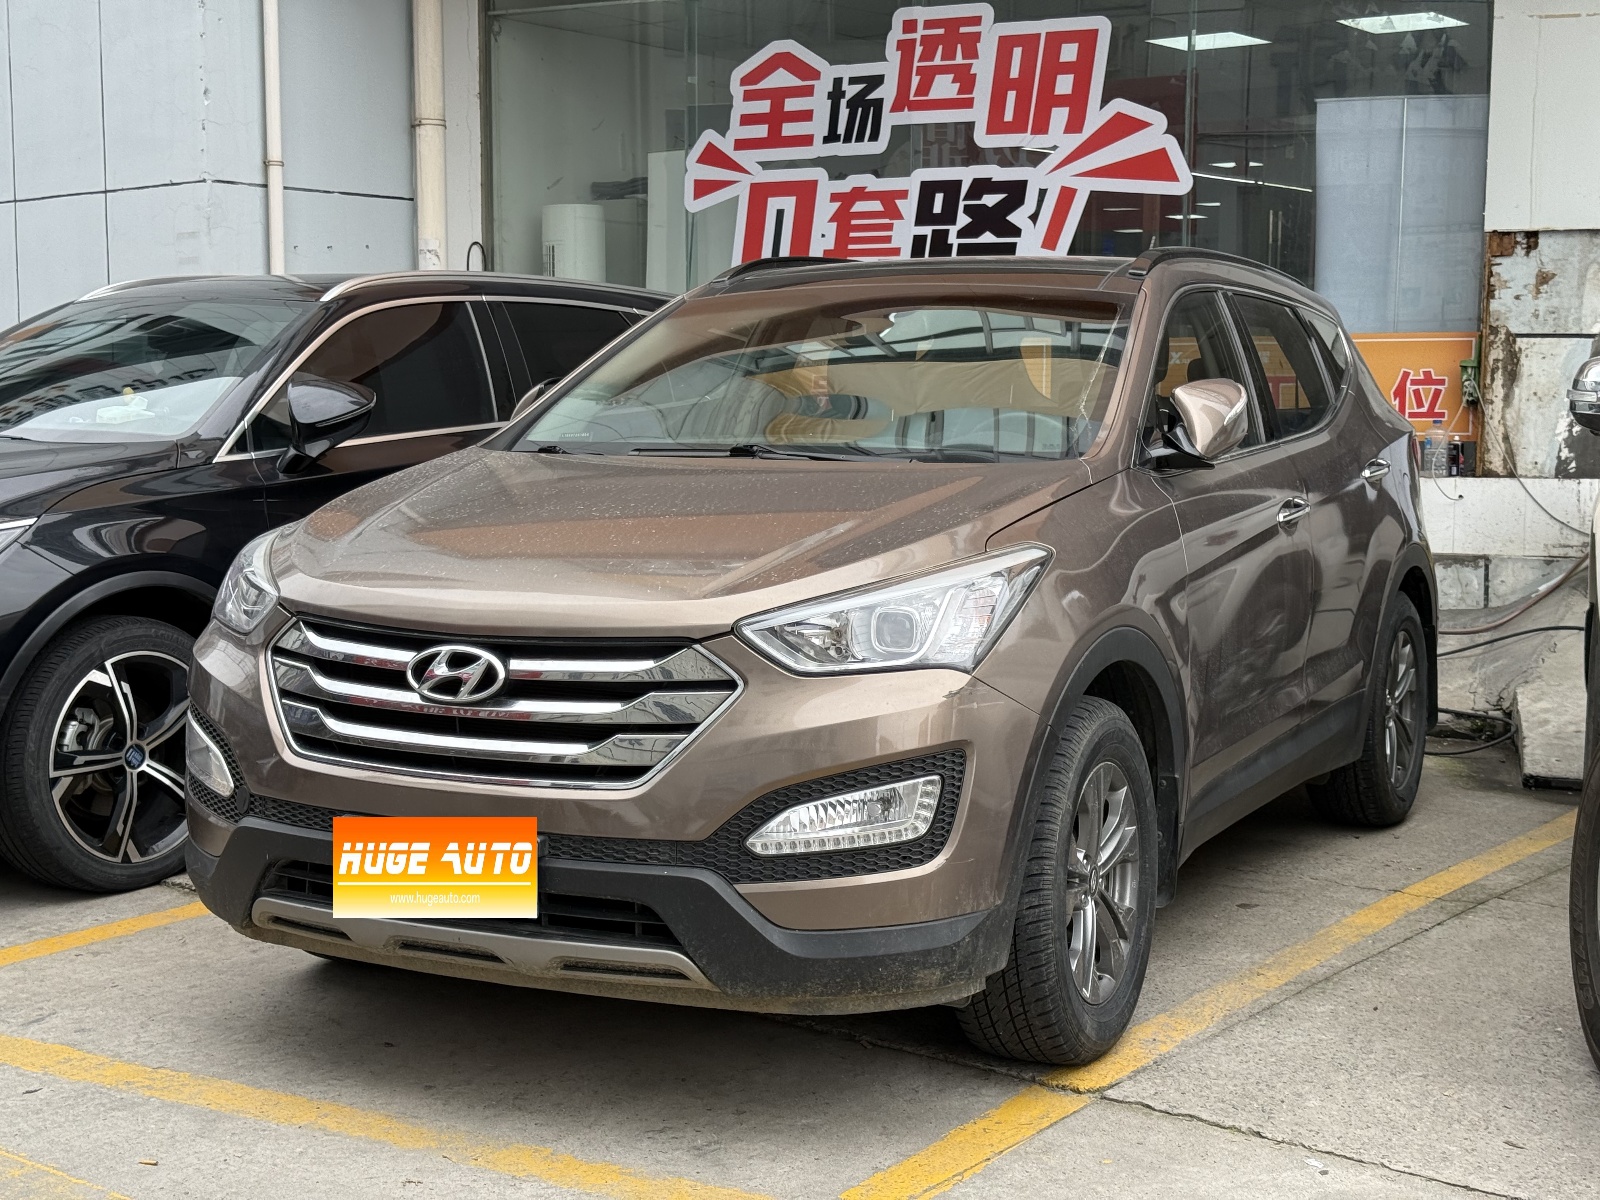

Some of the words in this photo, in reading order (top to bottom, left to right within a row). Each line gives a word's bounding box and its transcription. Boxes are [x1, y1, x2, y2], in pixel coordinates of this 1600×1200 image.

[733, 15, 1099, 152] 全场透明
[1392, 369, 1447, 420] 位
